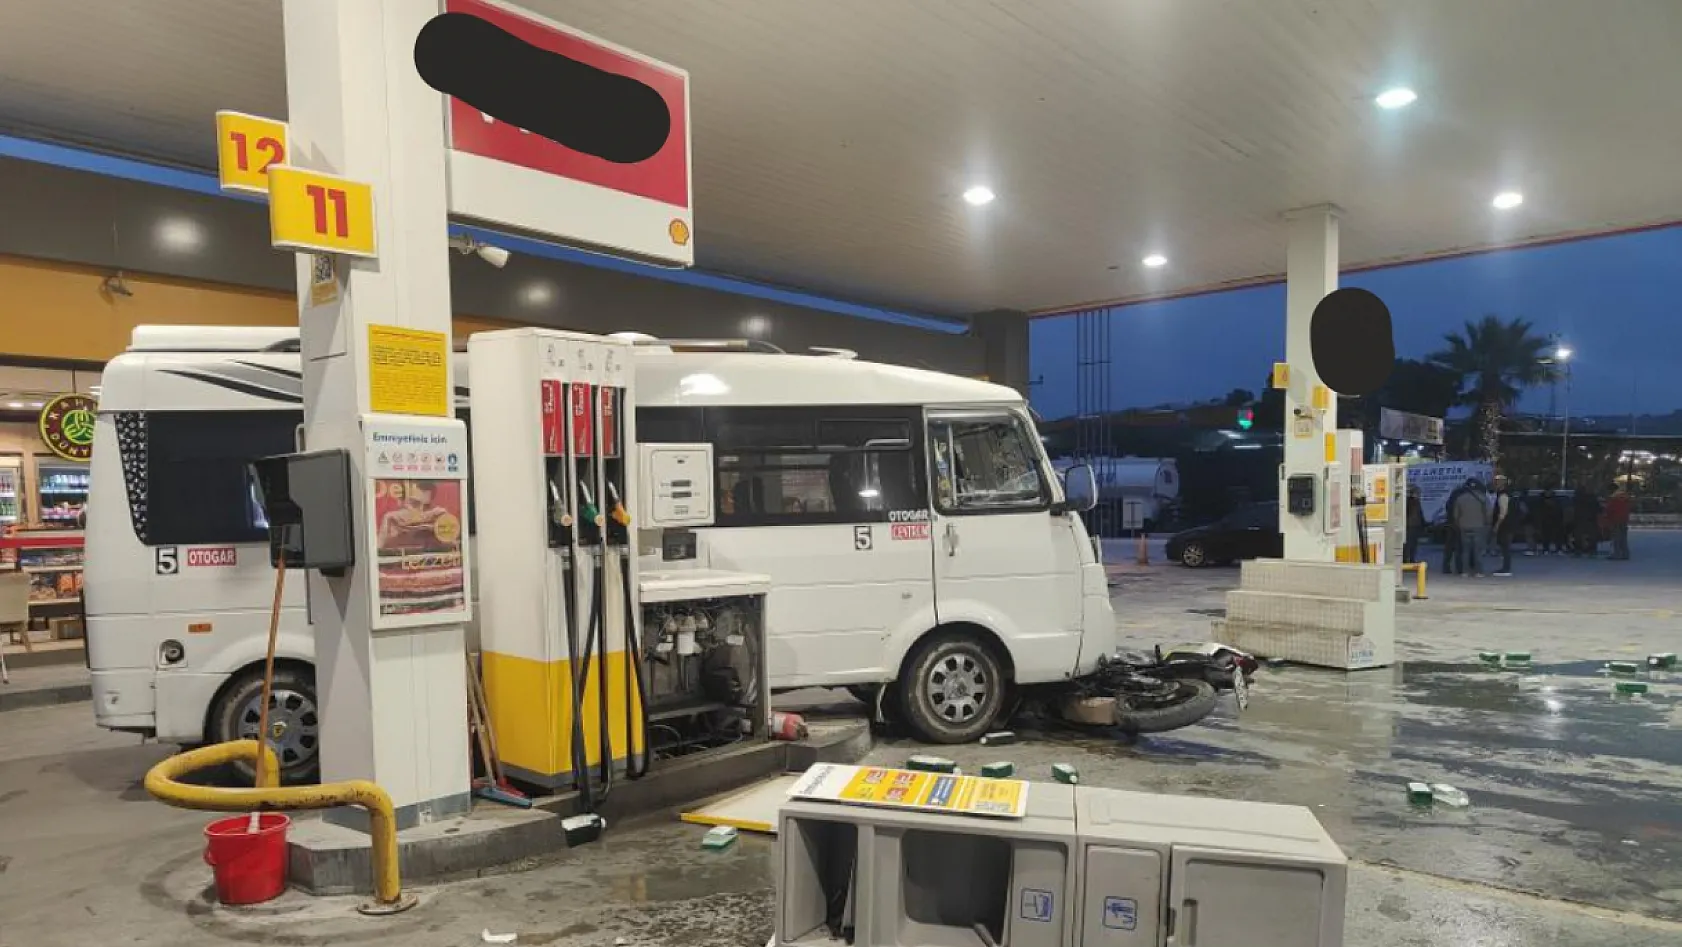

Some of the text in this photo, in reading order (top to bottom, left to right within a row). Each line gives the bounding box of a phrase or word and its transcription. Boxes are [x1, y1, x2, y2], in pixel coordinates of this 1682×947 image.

[230, 131, 284, 174] 12
[306, 184, 348, 238] 11
[888, 510, 928, 521] OTOGAR
[856, 526, 871, 549] 5
[157, 547, 235, 574] 5 OTOGAR
